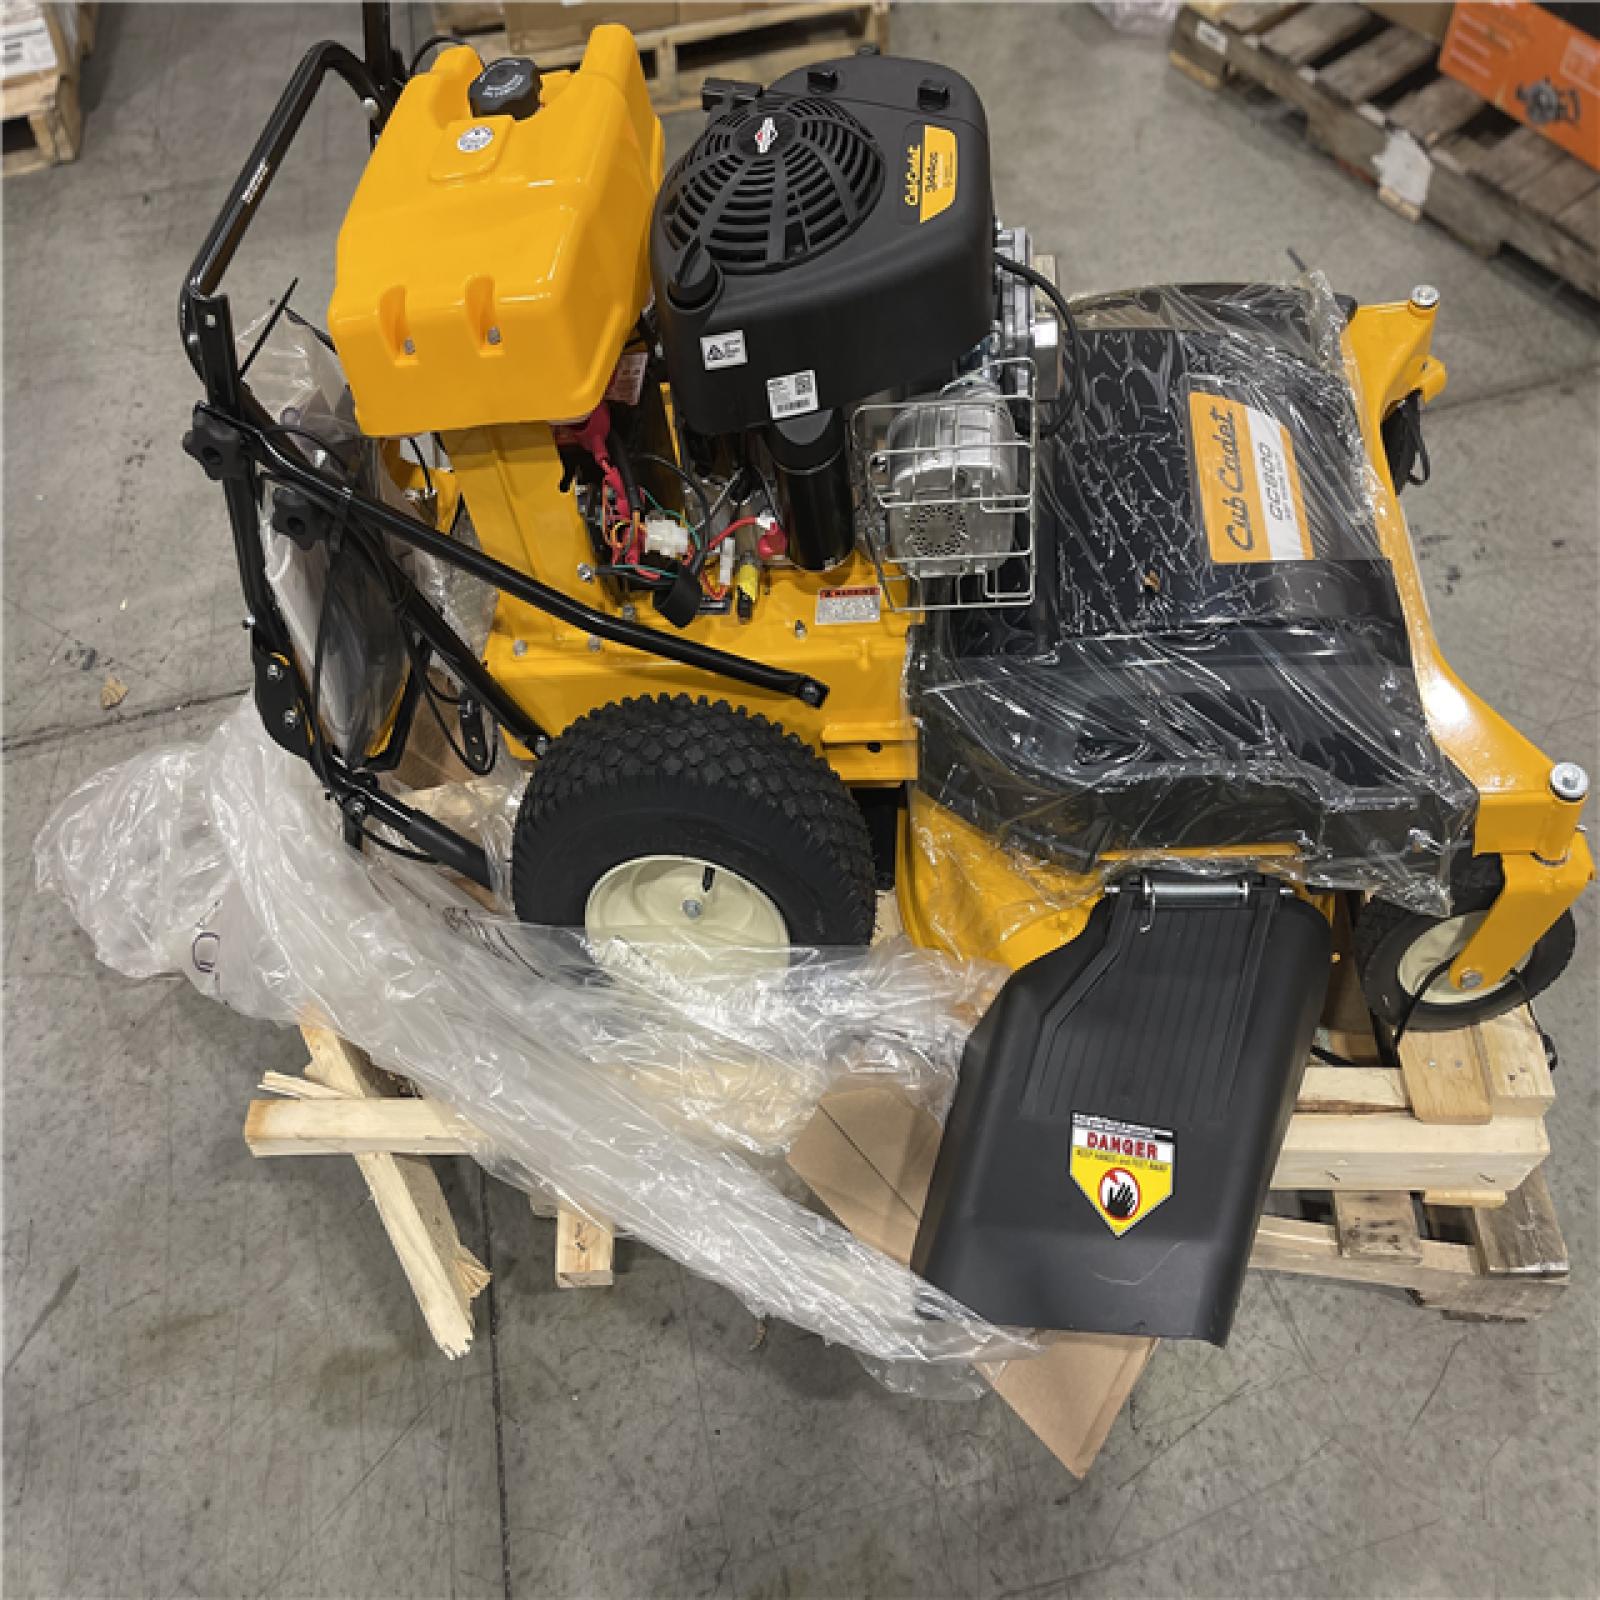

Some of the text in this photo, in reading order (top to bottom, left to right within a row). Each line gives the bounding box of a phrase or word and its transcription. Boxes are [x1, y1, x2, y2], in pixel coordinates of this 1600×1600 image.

[1210, 405, 1255, 552] Cub Cadet
[1087, 1131, 1158, 1160] DANGER
